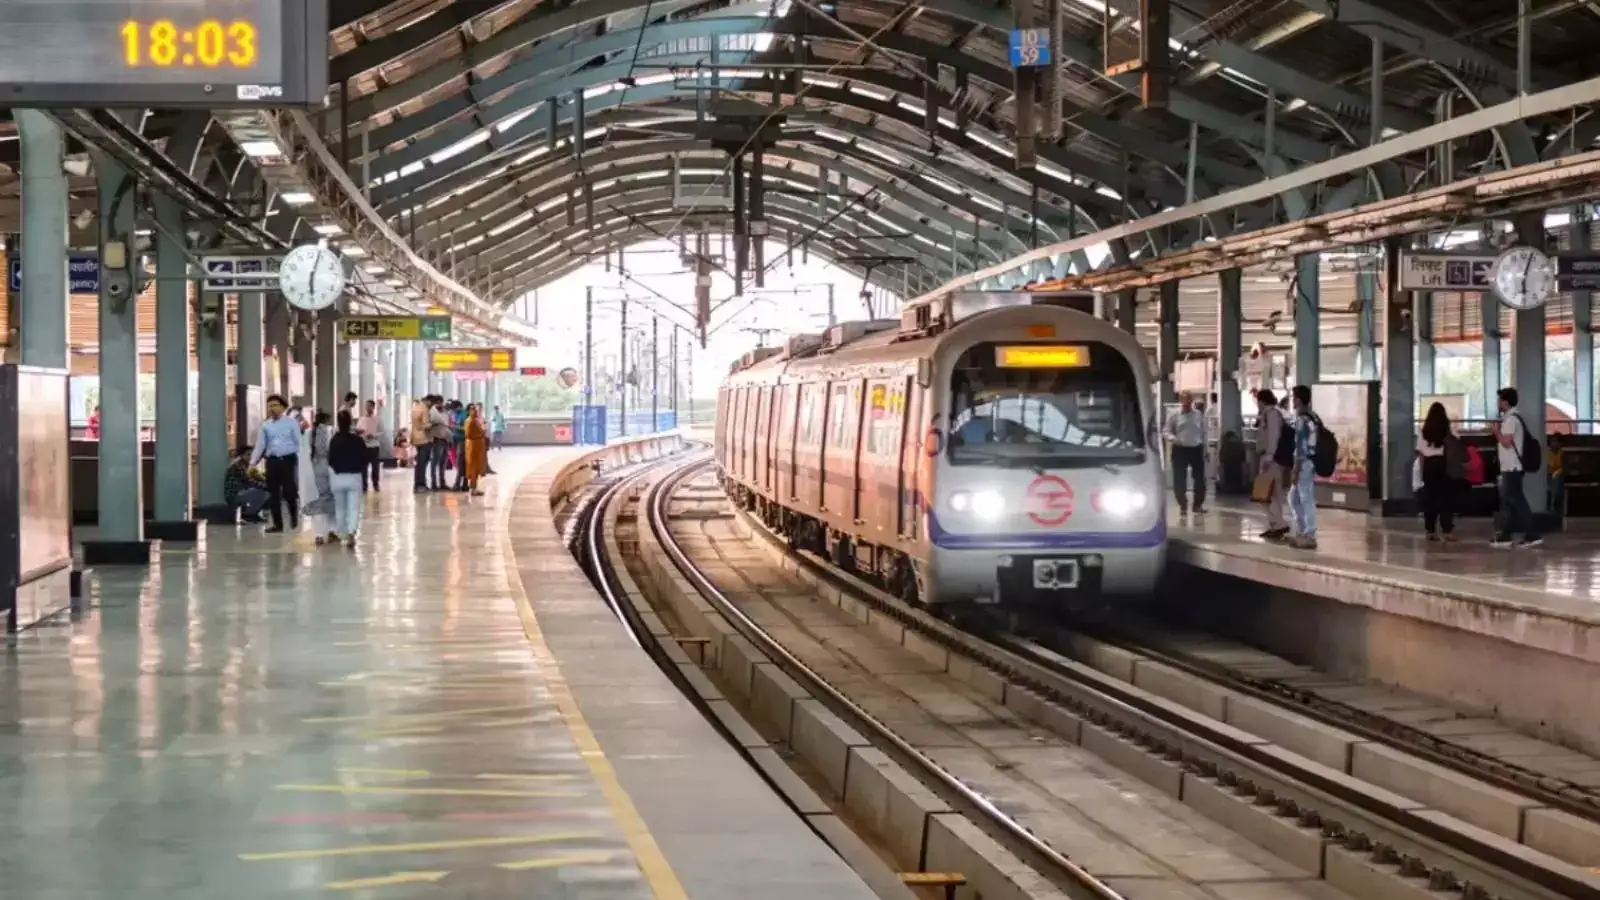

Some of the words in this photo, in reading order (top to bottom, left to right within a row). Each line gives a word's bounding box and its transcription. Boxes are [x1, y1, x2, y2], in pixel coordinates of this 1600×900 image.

[120, 19, 257, 68] 18:03
[69, 279, 99, 290] gency
[1422, 274, 1442, 286] Lift
